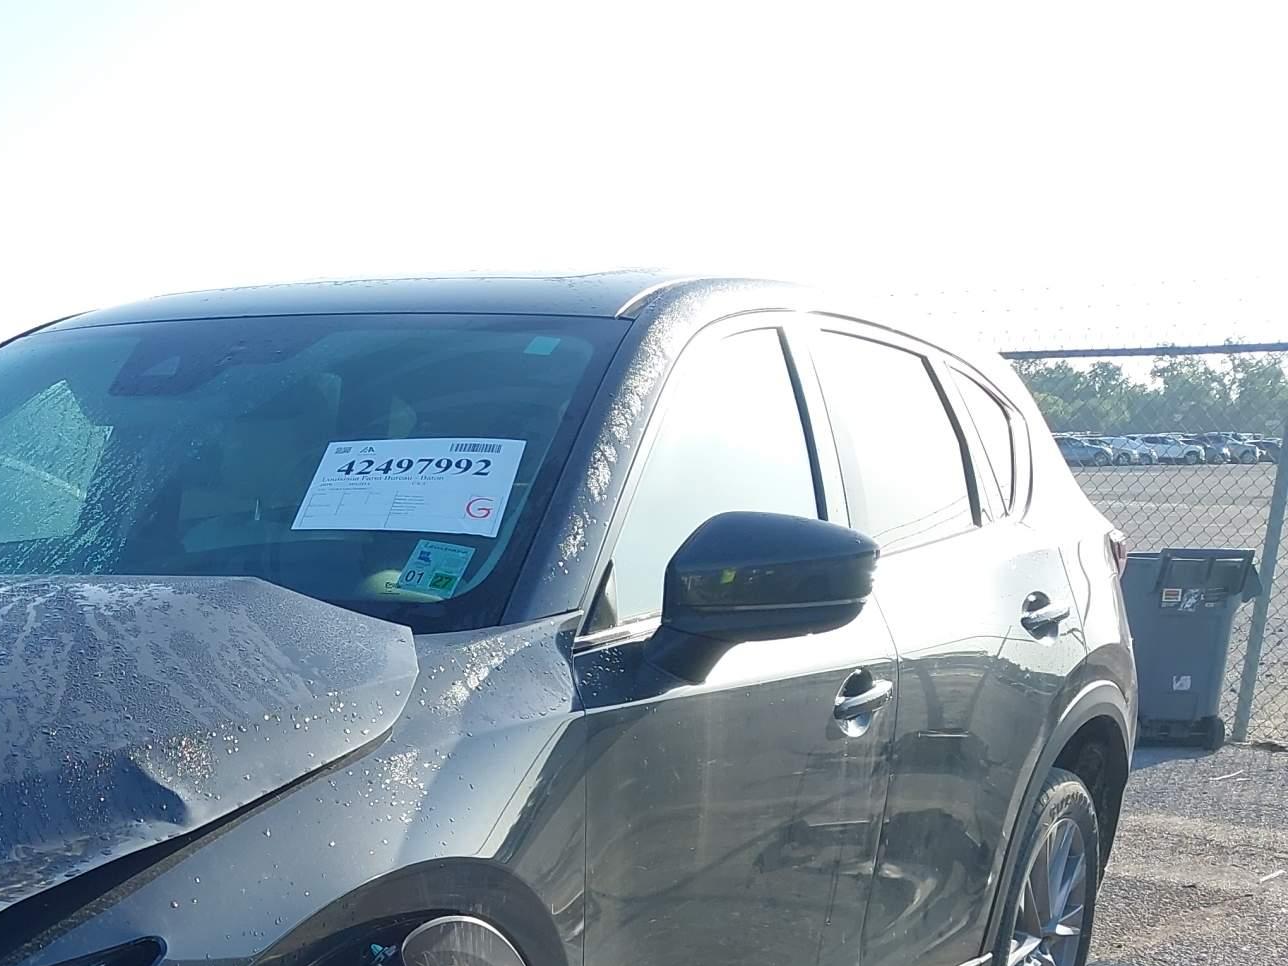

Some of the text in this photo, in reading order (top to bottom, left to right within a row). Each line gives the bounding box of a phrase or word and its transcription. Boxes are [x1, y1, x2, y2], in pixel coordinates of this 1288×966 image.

[336, 457, 492, 476] 42497992
[466, 497, 494, 519] G
[405, 570, 454, 590] 01 27
